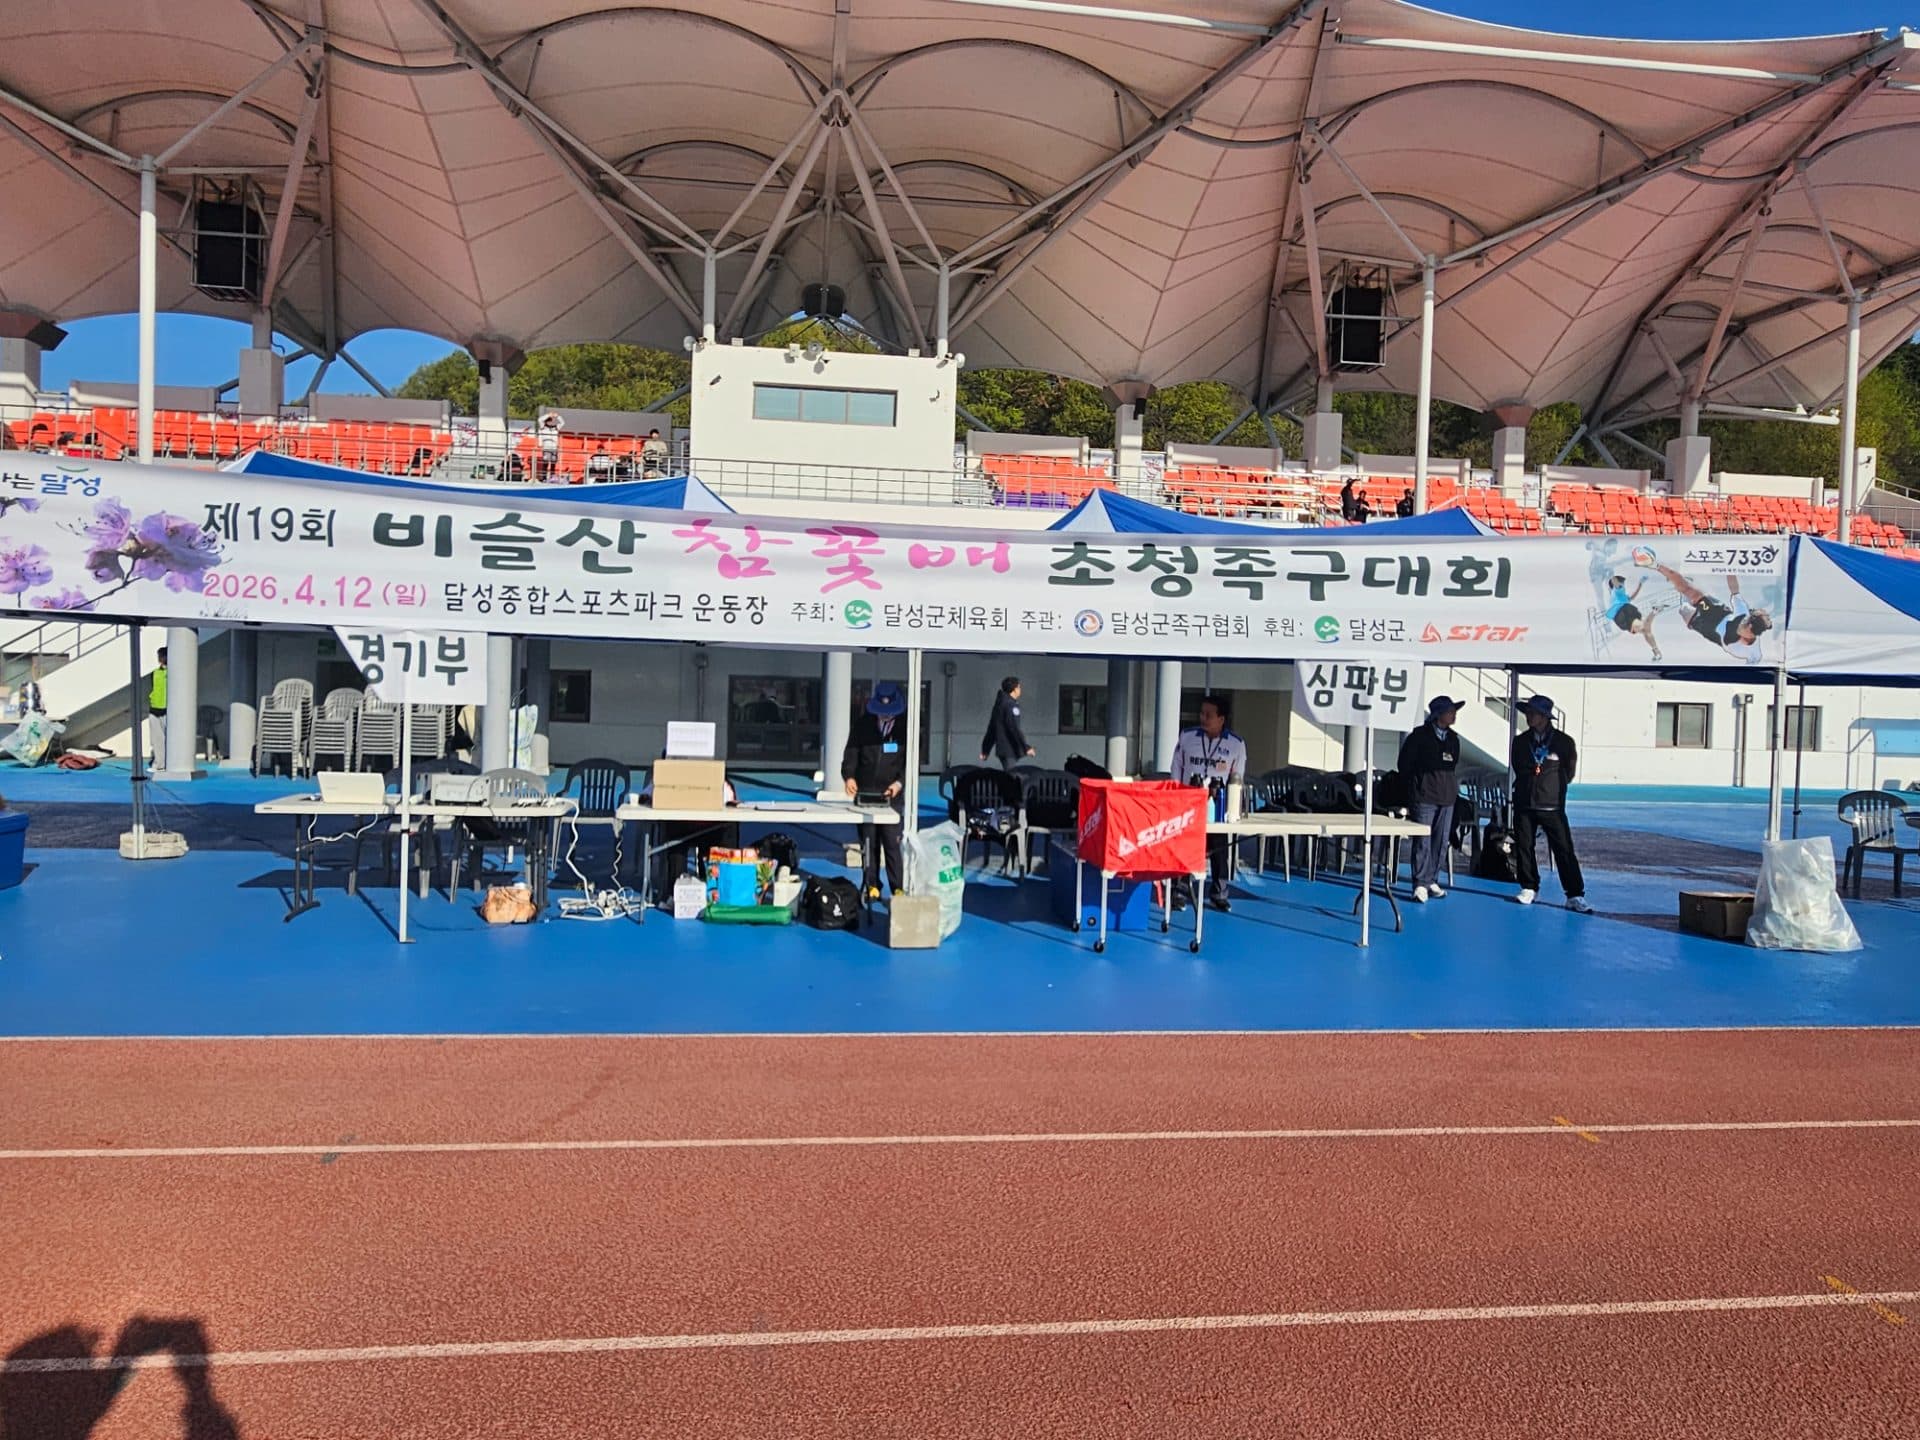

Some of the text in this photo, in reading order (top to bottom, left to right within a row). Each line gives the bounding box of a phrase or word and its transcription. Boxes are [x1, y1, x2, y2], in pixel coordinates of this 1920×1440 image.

[41, 473, 101, 497] 달성
[202, 502, 1512, 601] 제19회 비슬산 참꽃배 초청족구대회
[790, 601, 835, 624] 주최:
[883, 603, 1009, 632] 달성군체육회
[1020, 610, 1063, 632] 주관:
[1111, 612, 1250, 639] 달성군족구협회
[1263, 616, 1304, 638] 후원:
[1447, 624, 1529, 641] star
[347, 634, 469, 686] 경기부
[1306, 664, 1408, 714] 심판부
[1137, 808, 1195, 847] star
